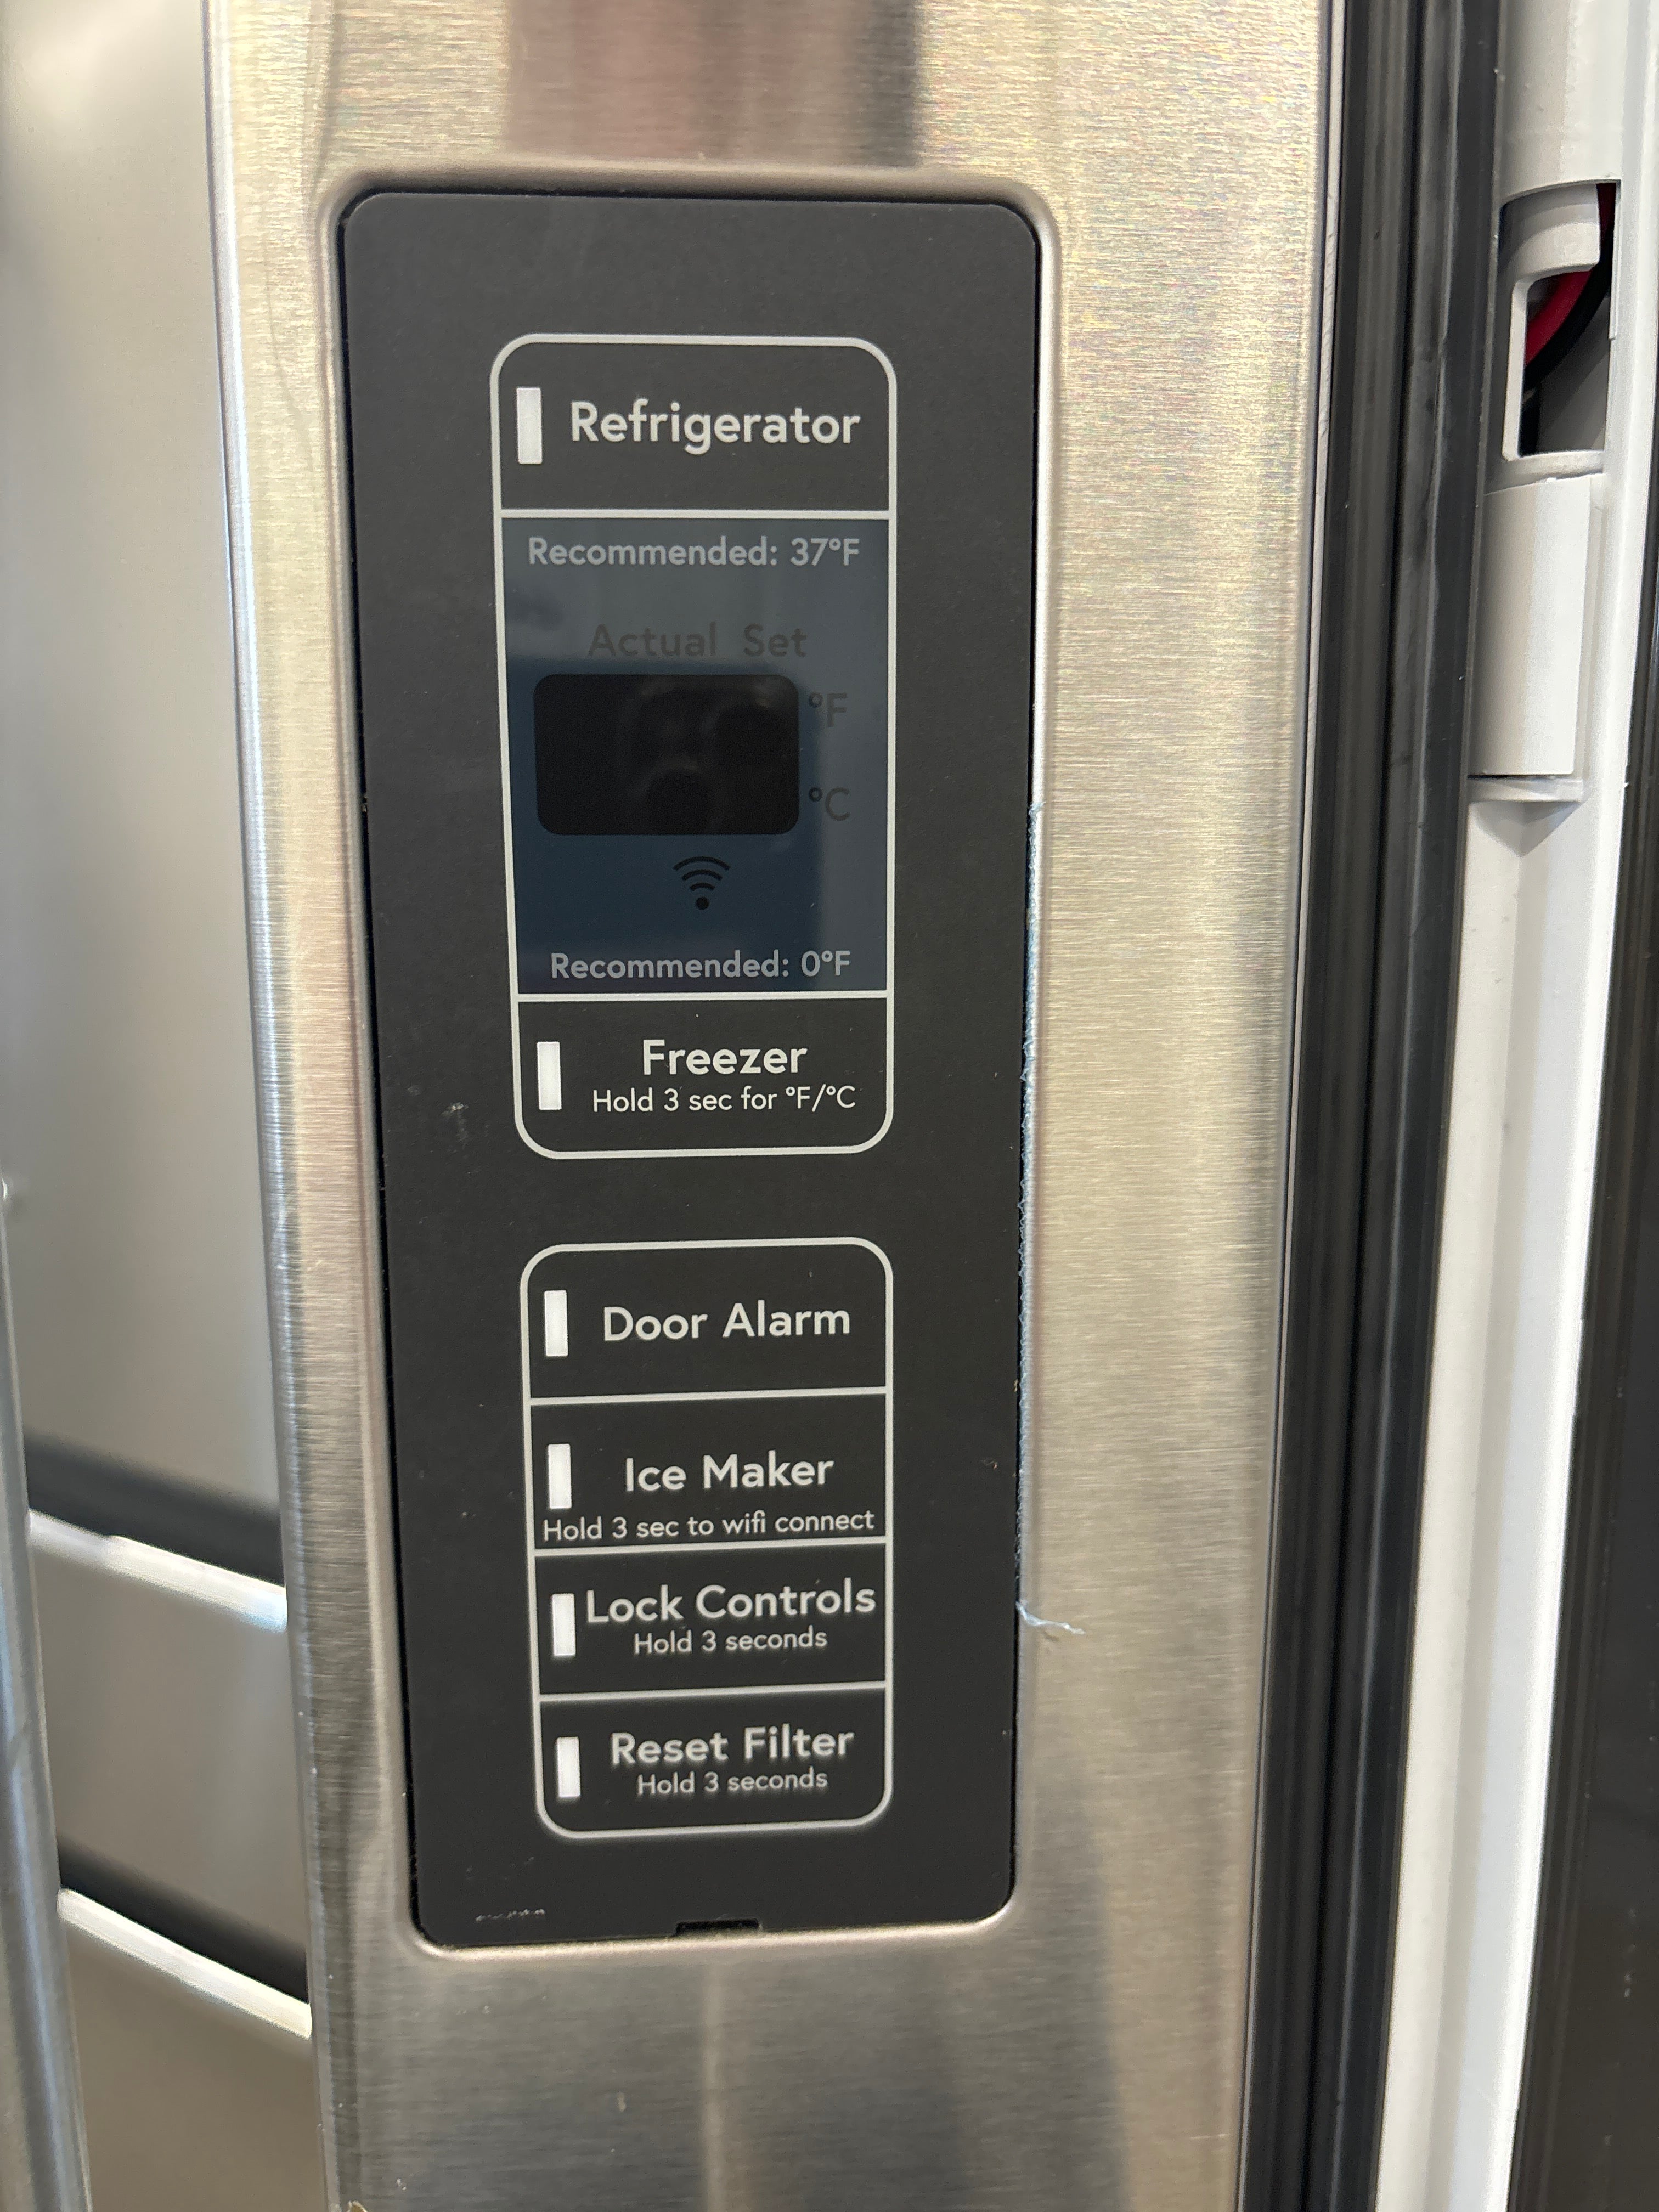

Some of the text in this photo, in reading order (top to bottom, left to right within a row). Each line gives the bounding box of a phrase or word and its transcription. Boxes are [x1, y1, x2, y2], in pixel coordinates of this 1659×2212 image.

[571, 398, 861, 455] Refrigerator
[528, 536, 860, 567] Recommended: 37°F
[743, 625, 808, 658] Set
[551, 950, 851, 979] Recommended: 0°F
[642, 1039, 808, 1076] Freezer
[592, 1084, 856, 1113] Hold 3 sec for °F/°C
[603, 1299, 851, 1342] Door Alarm
[626, 1450, 834, 1492] Ice Maker
[543, 1510, 874, 1541] Hold 3 sec to wifi connect
[586, 1578, 877, 1623] Lock Controls
[634, 1626, 828, 1655] Hold 3 seconds
[611, 1724, 855, 1765] Reset Filter
[637, 1766, 828, 1796] Hold 3 seconds
